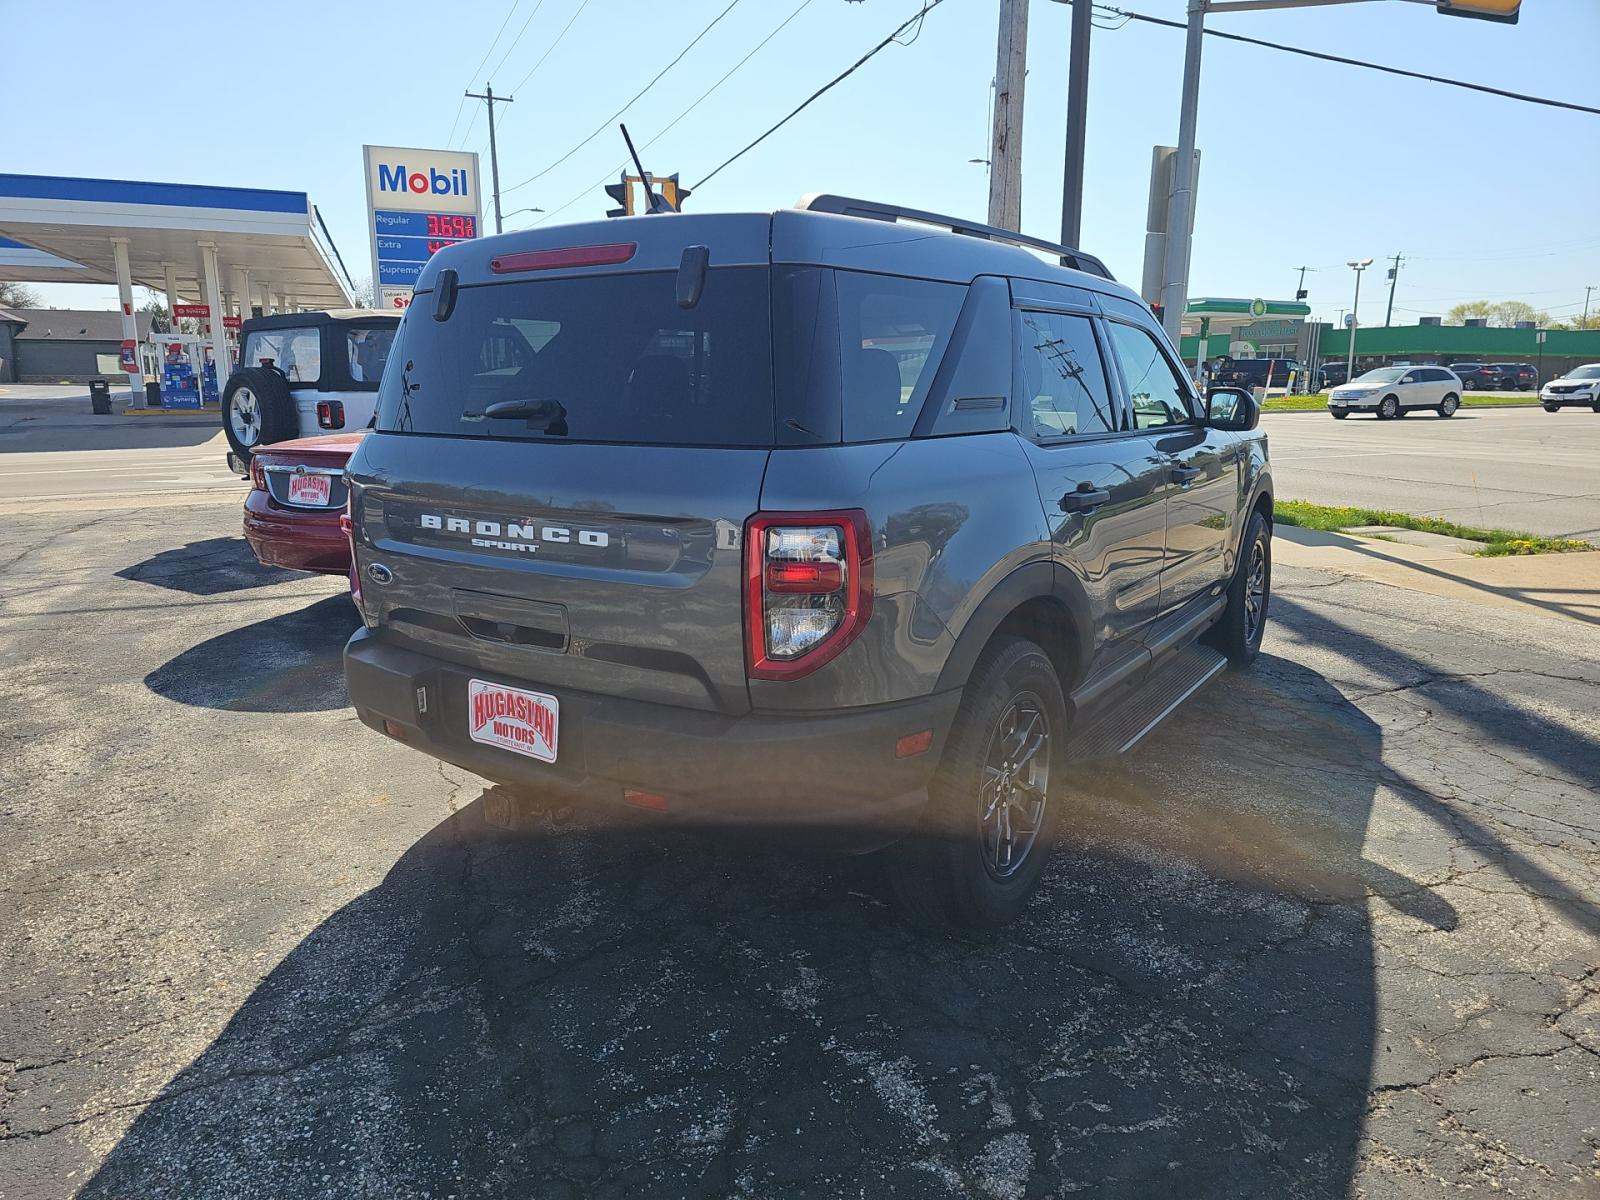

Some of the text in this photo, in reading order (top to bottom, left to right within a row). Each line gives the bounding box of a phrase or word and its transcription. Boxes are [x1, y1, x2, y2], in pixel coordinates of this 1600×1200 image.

[378, 164, 468, 196] Mobil
[377, 215, 411, 226] Regular
[378, 240, 402, 249] Extra
[291, 476, 328, 498] HUGASIAN
[420, 513, 610, 548] BRONCO
[471, 538, 540, 553] SPORT
[473, 689, 555, 750] HUGASIAN
[494, 721, 535, 744] MOTORS
